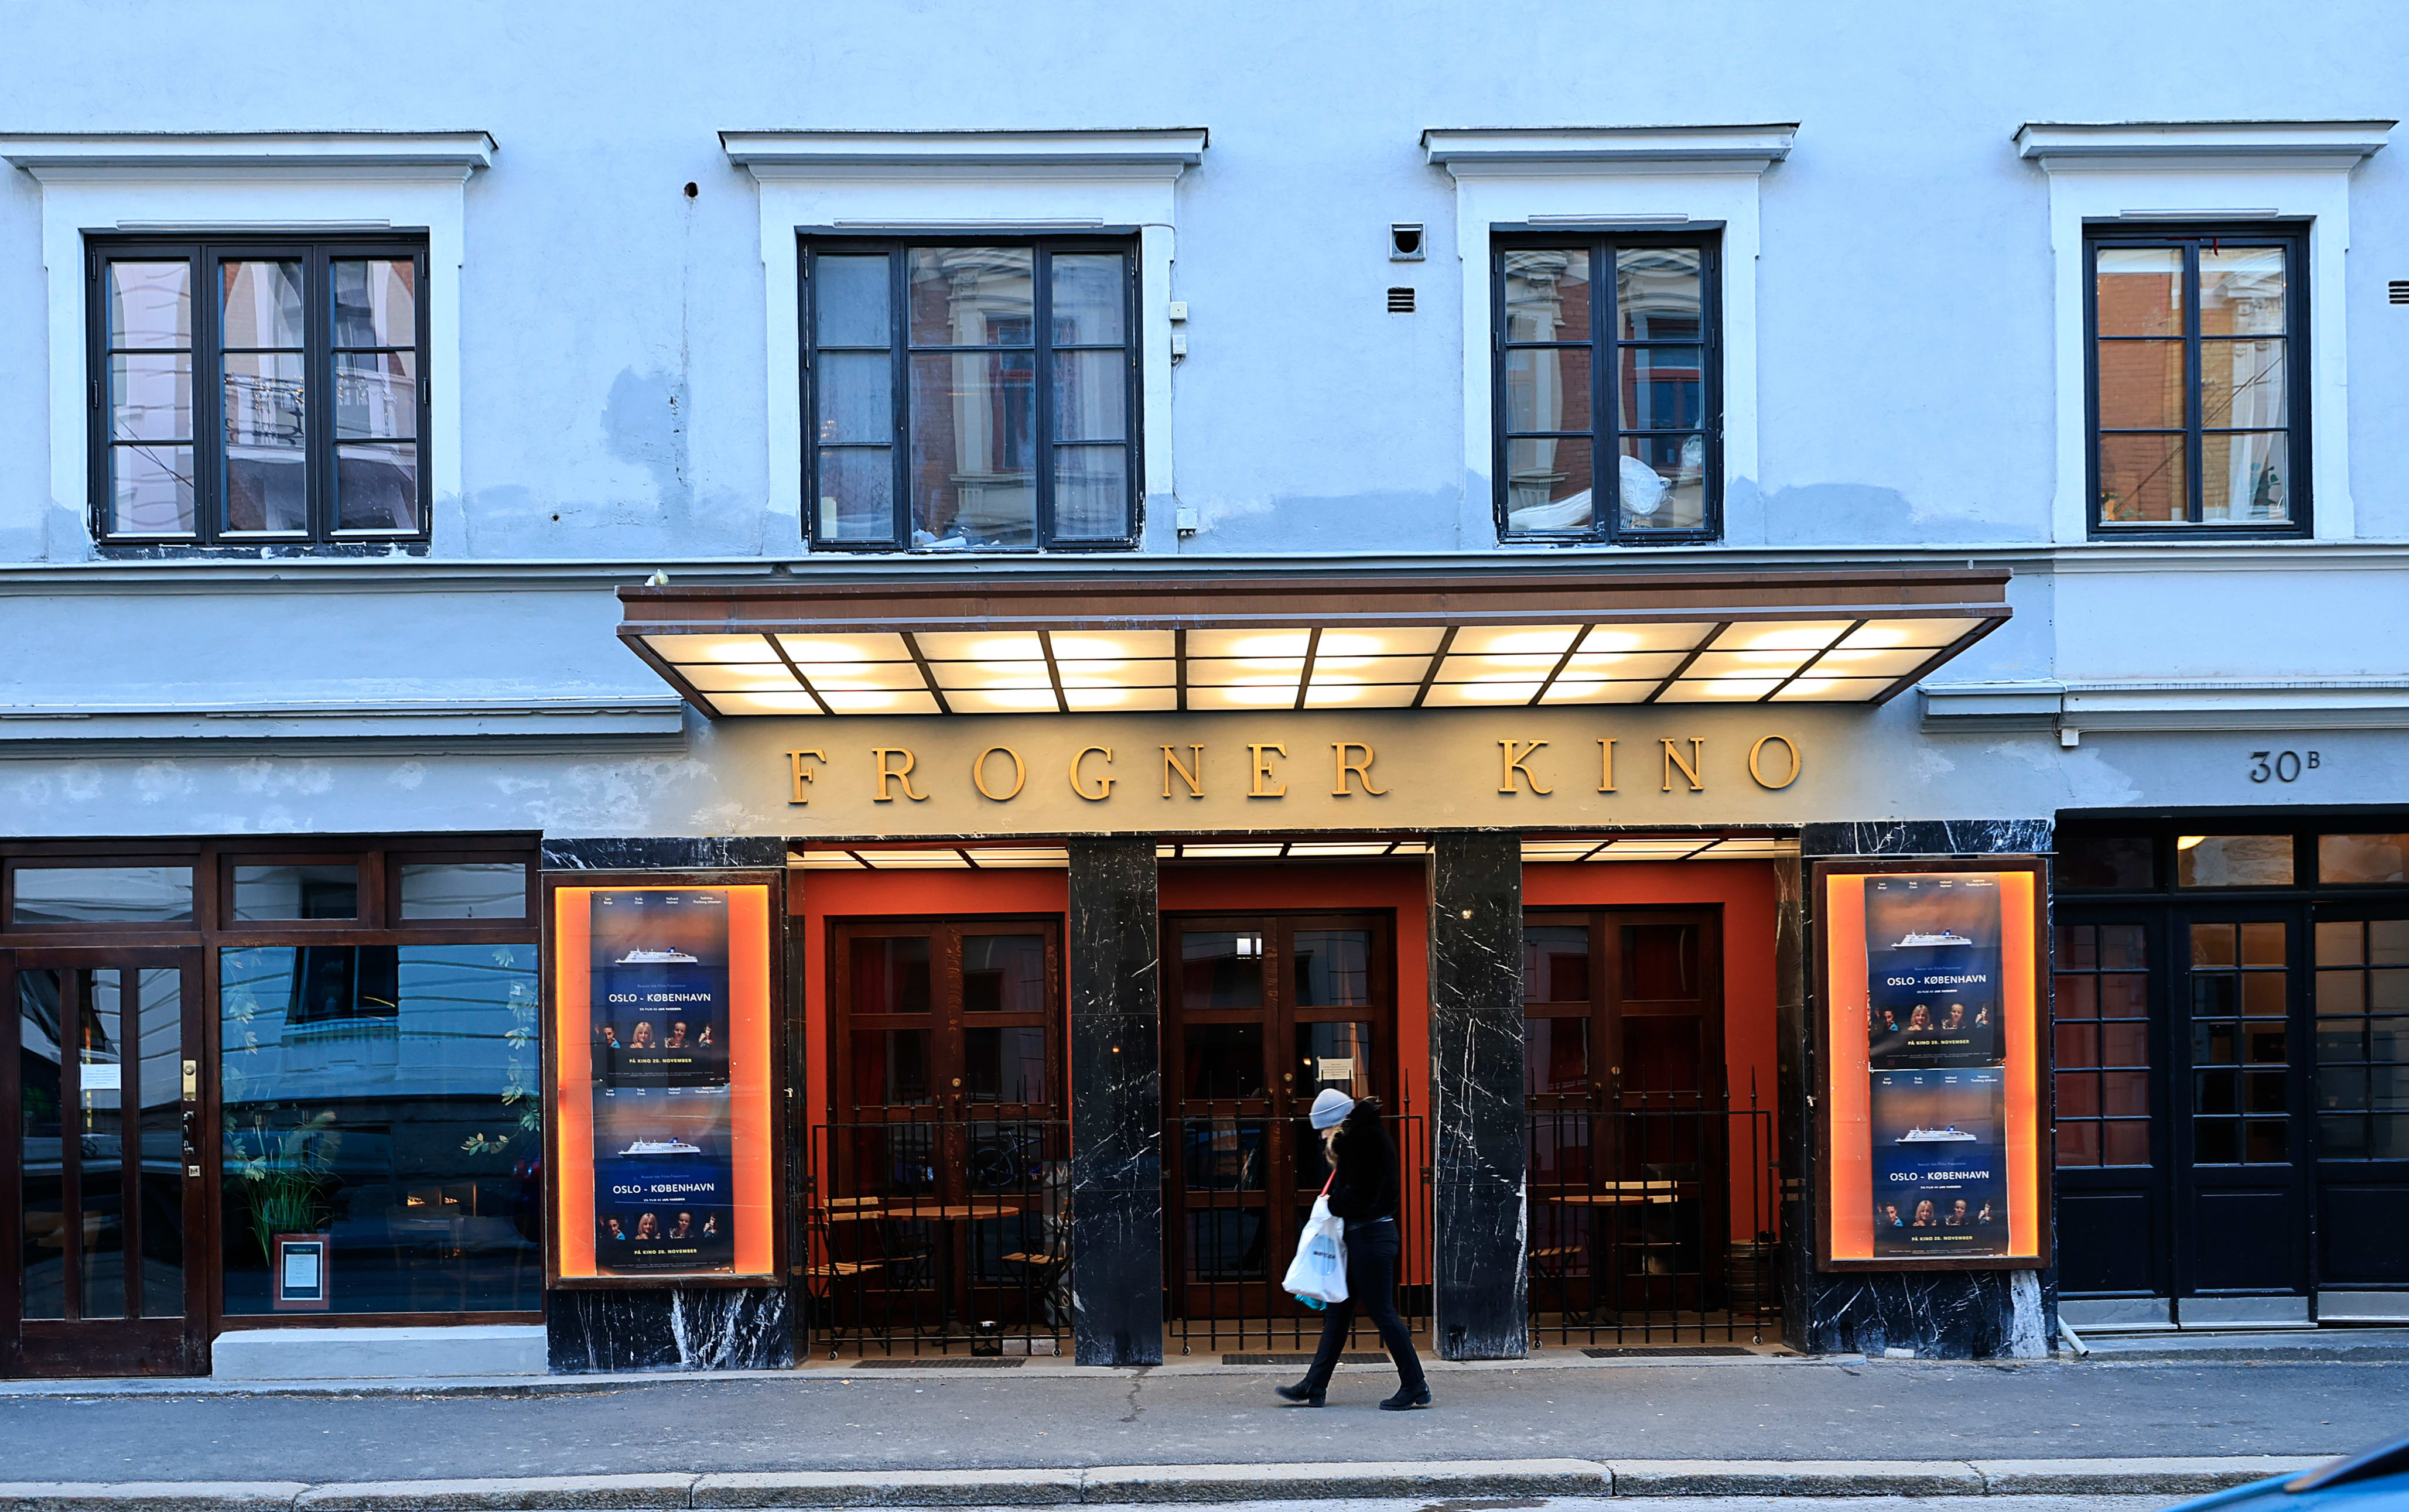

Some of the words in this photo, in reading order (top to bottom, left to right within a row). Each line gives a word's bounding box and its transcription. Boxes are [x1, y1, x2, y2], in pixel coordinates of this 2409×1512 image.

[786, 741, 1389, 805] FROGNER
[1497, 734, 1802, 795] KINO
[1887, 977, 1915, 986] OSLO
[1924, 974, 1986, 984] KØBENHAVN
[609, 994, 637, 1003] OSLO
[647, 993, 711, 1002] KØBENHAVN
[1889, 1172, 1918, 1181] OSLO
[1928, 1171, 1989, 1180] KØBENHAVN
[613, 1185, 641, 1194] OSLO
[651, 1183, 715, 1193] KØBENHAVN
